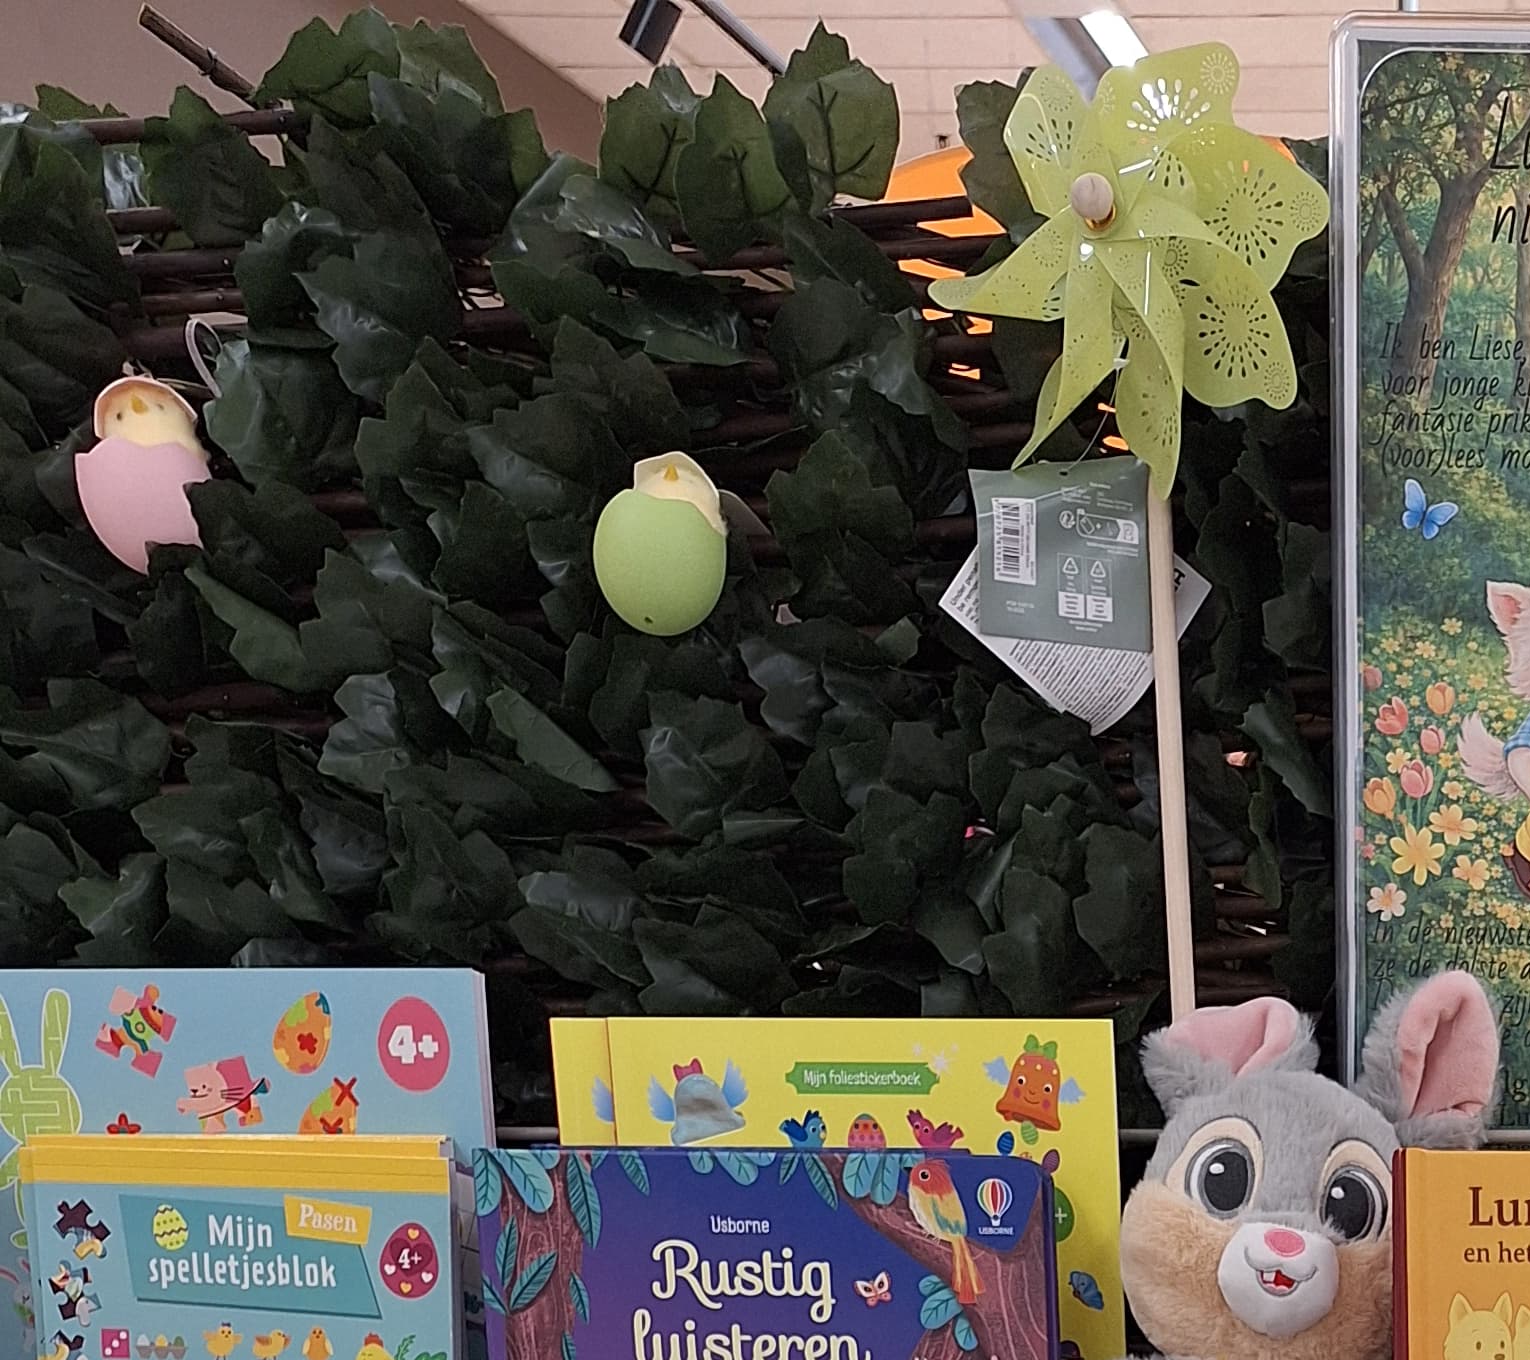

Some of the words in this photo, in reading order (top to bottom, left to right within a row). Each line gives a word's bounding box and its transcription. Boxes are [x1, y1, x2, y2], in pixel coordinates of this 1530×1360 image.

[1380, 322, 1400, 360] Ik
[1420, 324, 1455, 360] ben
[1470, 325, 1527, 367] Liese,
[1381, 372, 1429, 396] voor
[1431, 371, 1500, 410] jonge
[1370, 400, 1474, 445] fantasie
[1381, 431, 1486, 477] (voor)lees
[1370, 917, 1394, 943] In
[1408, 912, 1432, 944] de
[1372, 959, 1395, 979] ze
[1408, 946, 1432, 979] de
[1446, 949, 1507, 980] dolste
[388, 1024, 439, 1064] 4+
[802, 1069, 826, 1088] Mijn
[828, 1068, 922, 1088] foliestickerboek
[207, 1213, 273, 1251] Mijn
[298, 1203, 359, 1235] Pasen
[710, 1216, 770, 1234] Usborne
[978, 1227, 1014, 1236] USBORNE
[148, 1242, 338, 1291] spelletjesblok
[398, 1246, 423, 1269] 4+
[1463, 1245, 1490, 1262] en
[651, 1239, 836, 1323] Rustig
